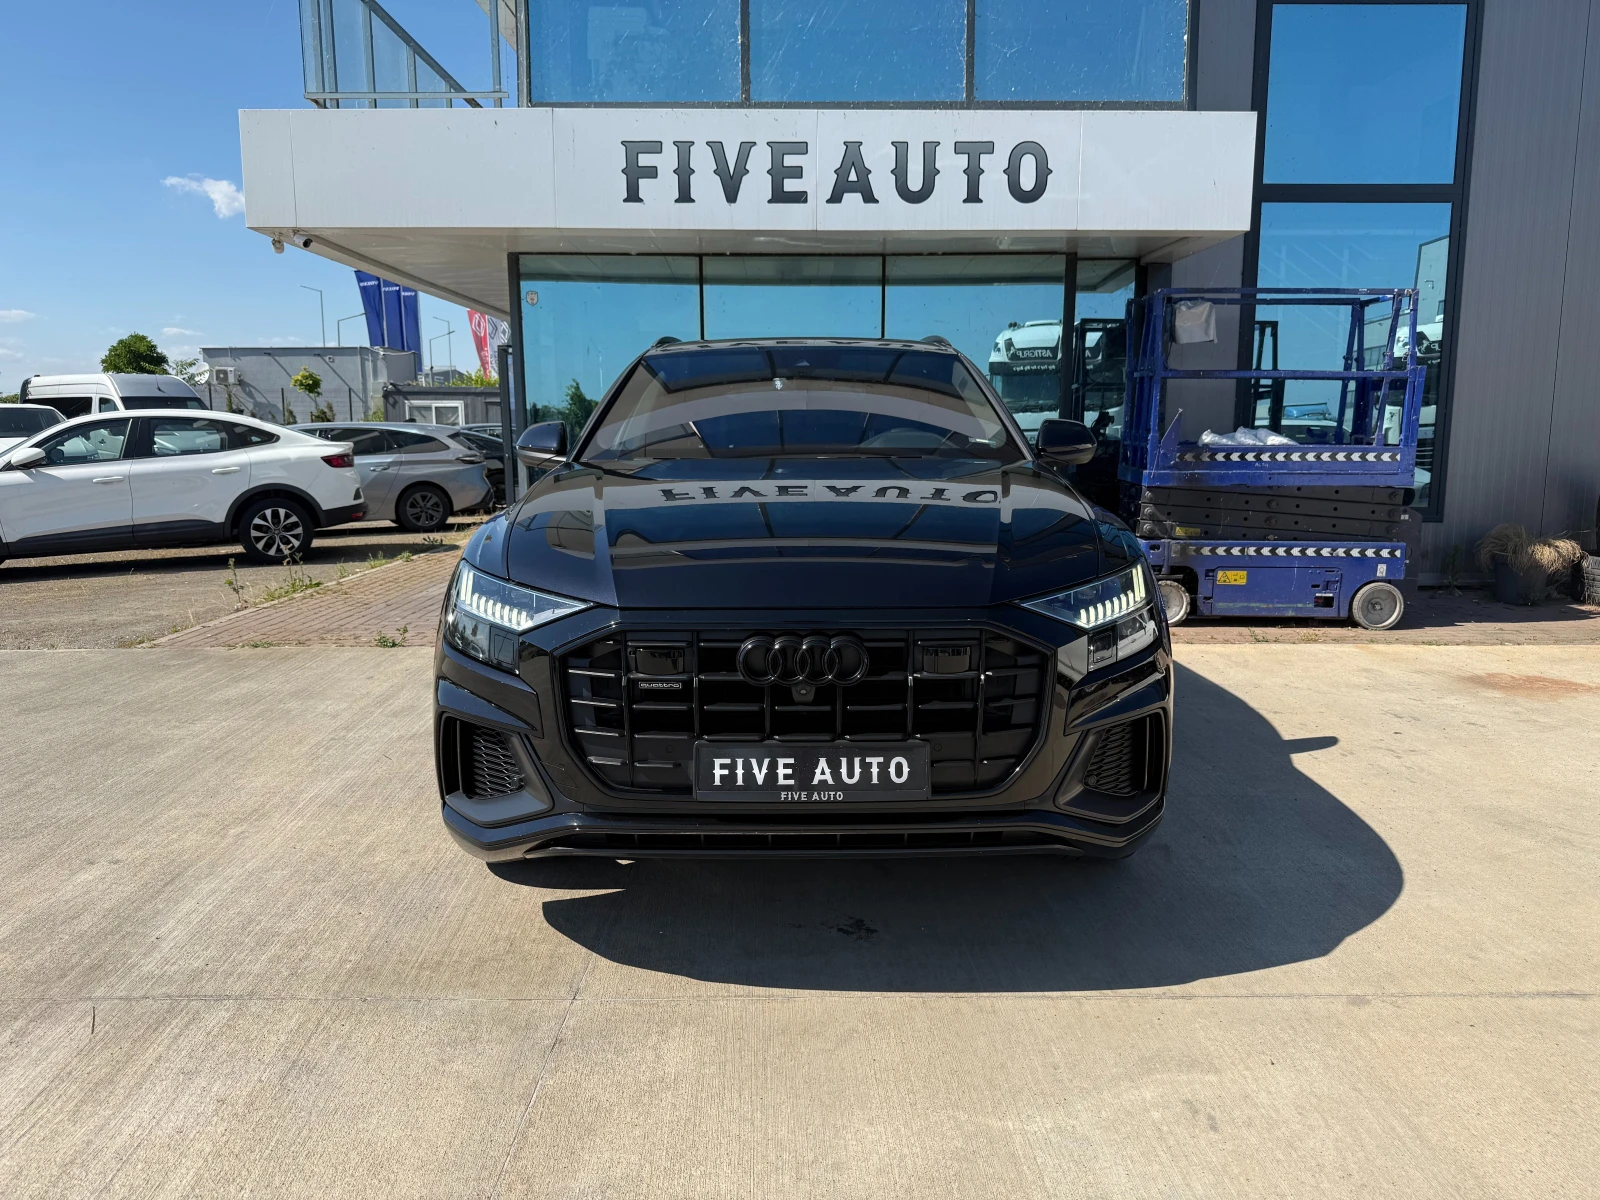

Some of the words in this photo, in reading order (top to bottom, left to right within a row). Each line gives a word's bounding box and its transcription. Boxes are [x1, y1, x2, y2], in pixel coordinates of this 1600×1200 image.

[712, 758, 795, 786] FIVE
[811, 757, 911, 785] AUTO
[780, 791, 808, 801] FIVE
[811, 791, 844, 801] AUTO
